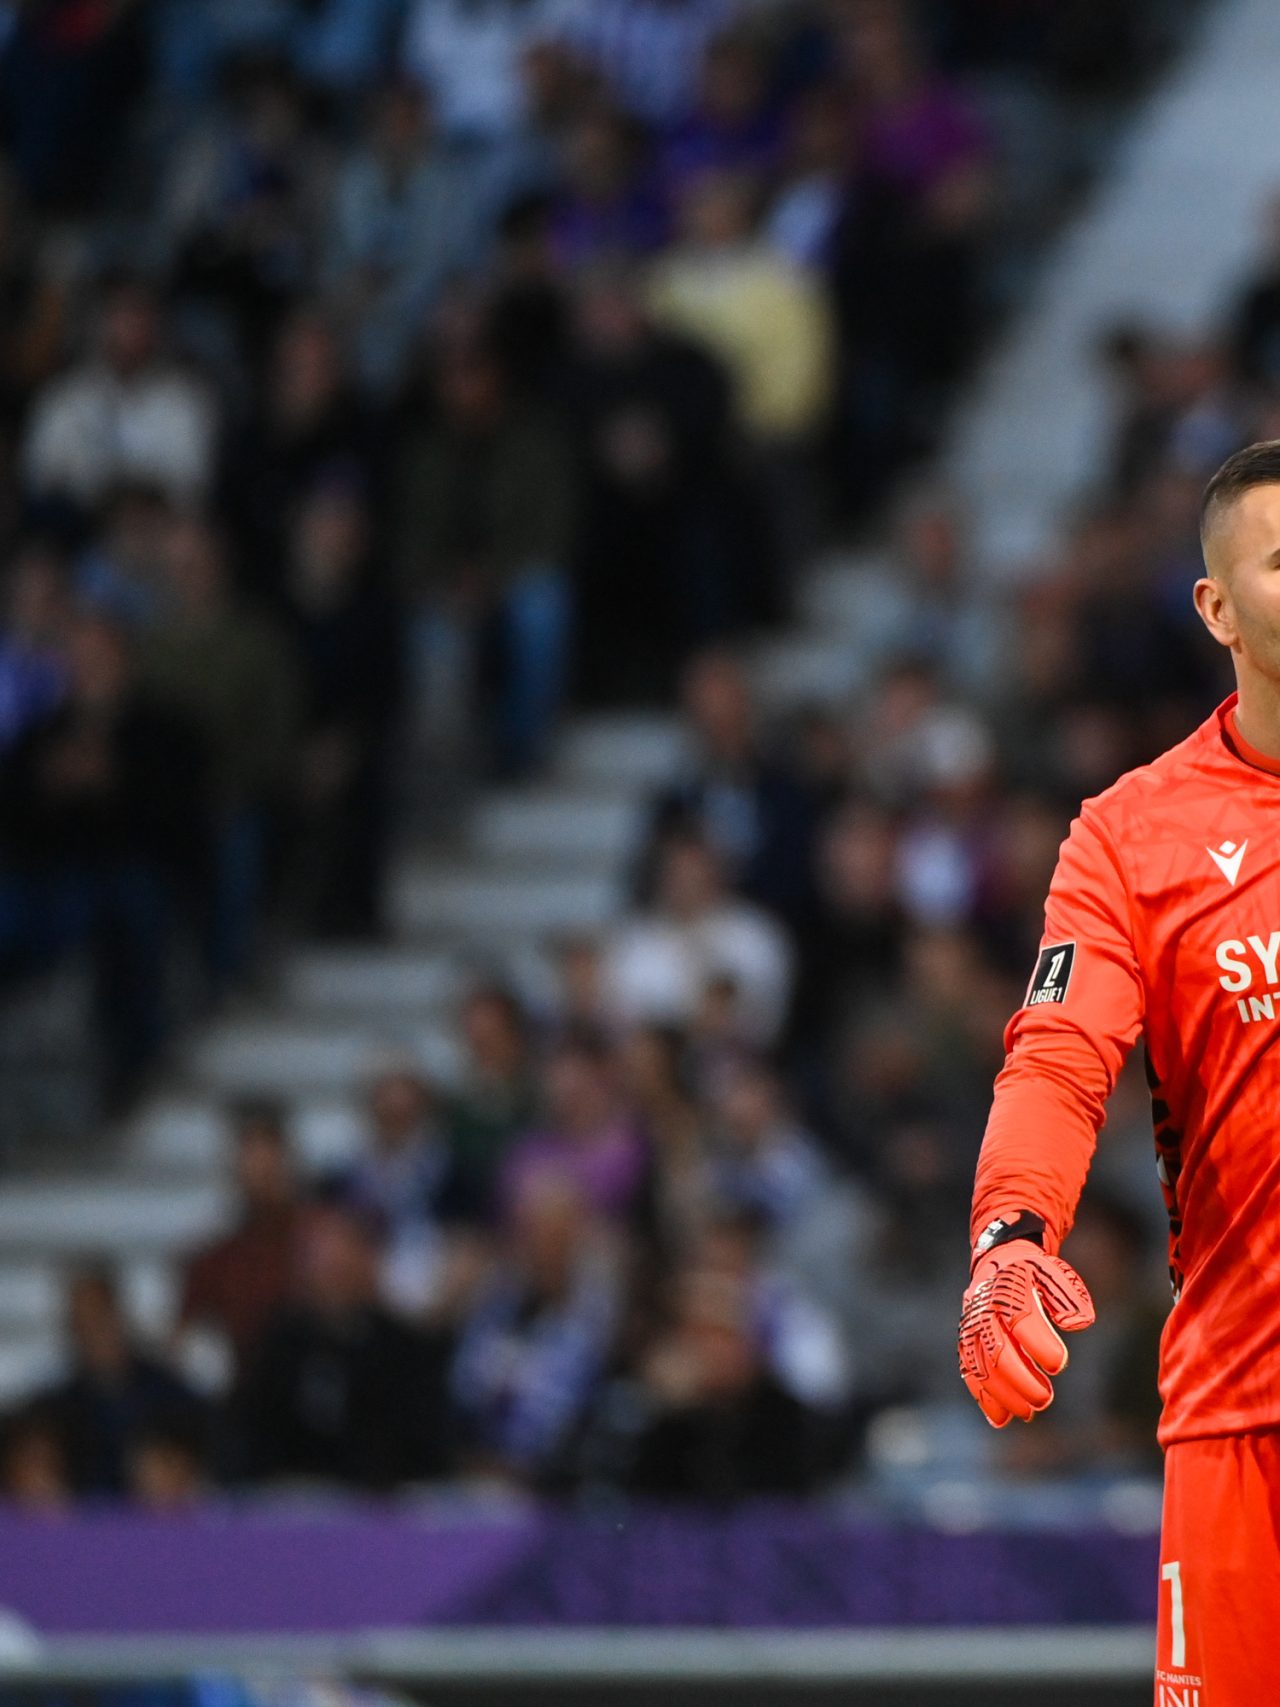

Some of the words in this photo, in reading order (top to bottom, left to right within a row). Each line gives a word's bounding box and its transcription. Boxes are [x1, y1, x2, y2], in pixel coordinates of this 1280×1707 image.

[1029, 987, 1058, 1005] LIGUE
[1161, 1560, 1186, 1668] 1
[1166, 1672, 1202, 1687] NANTES
